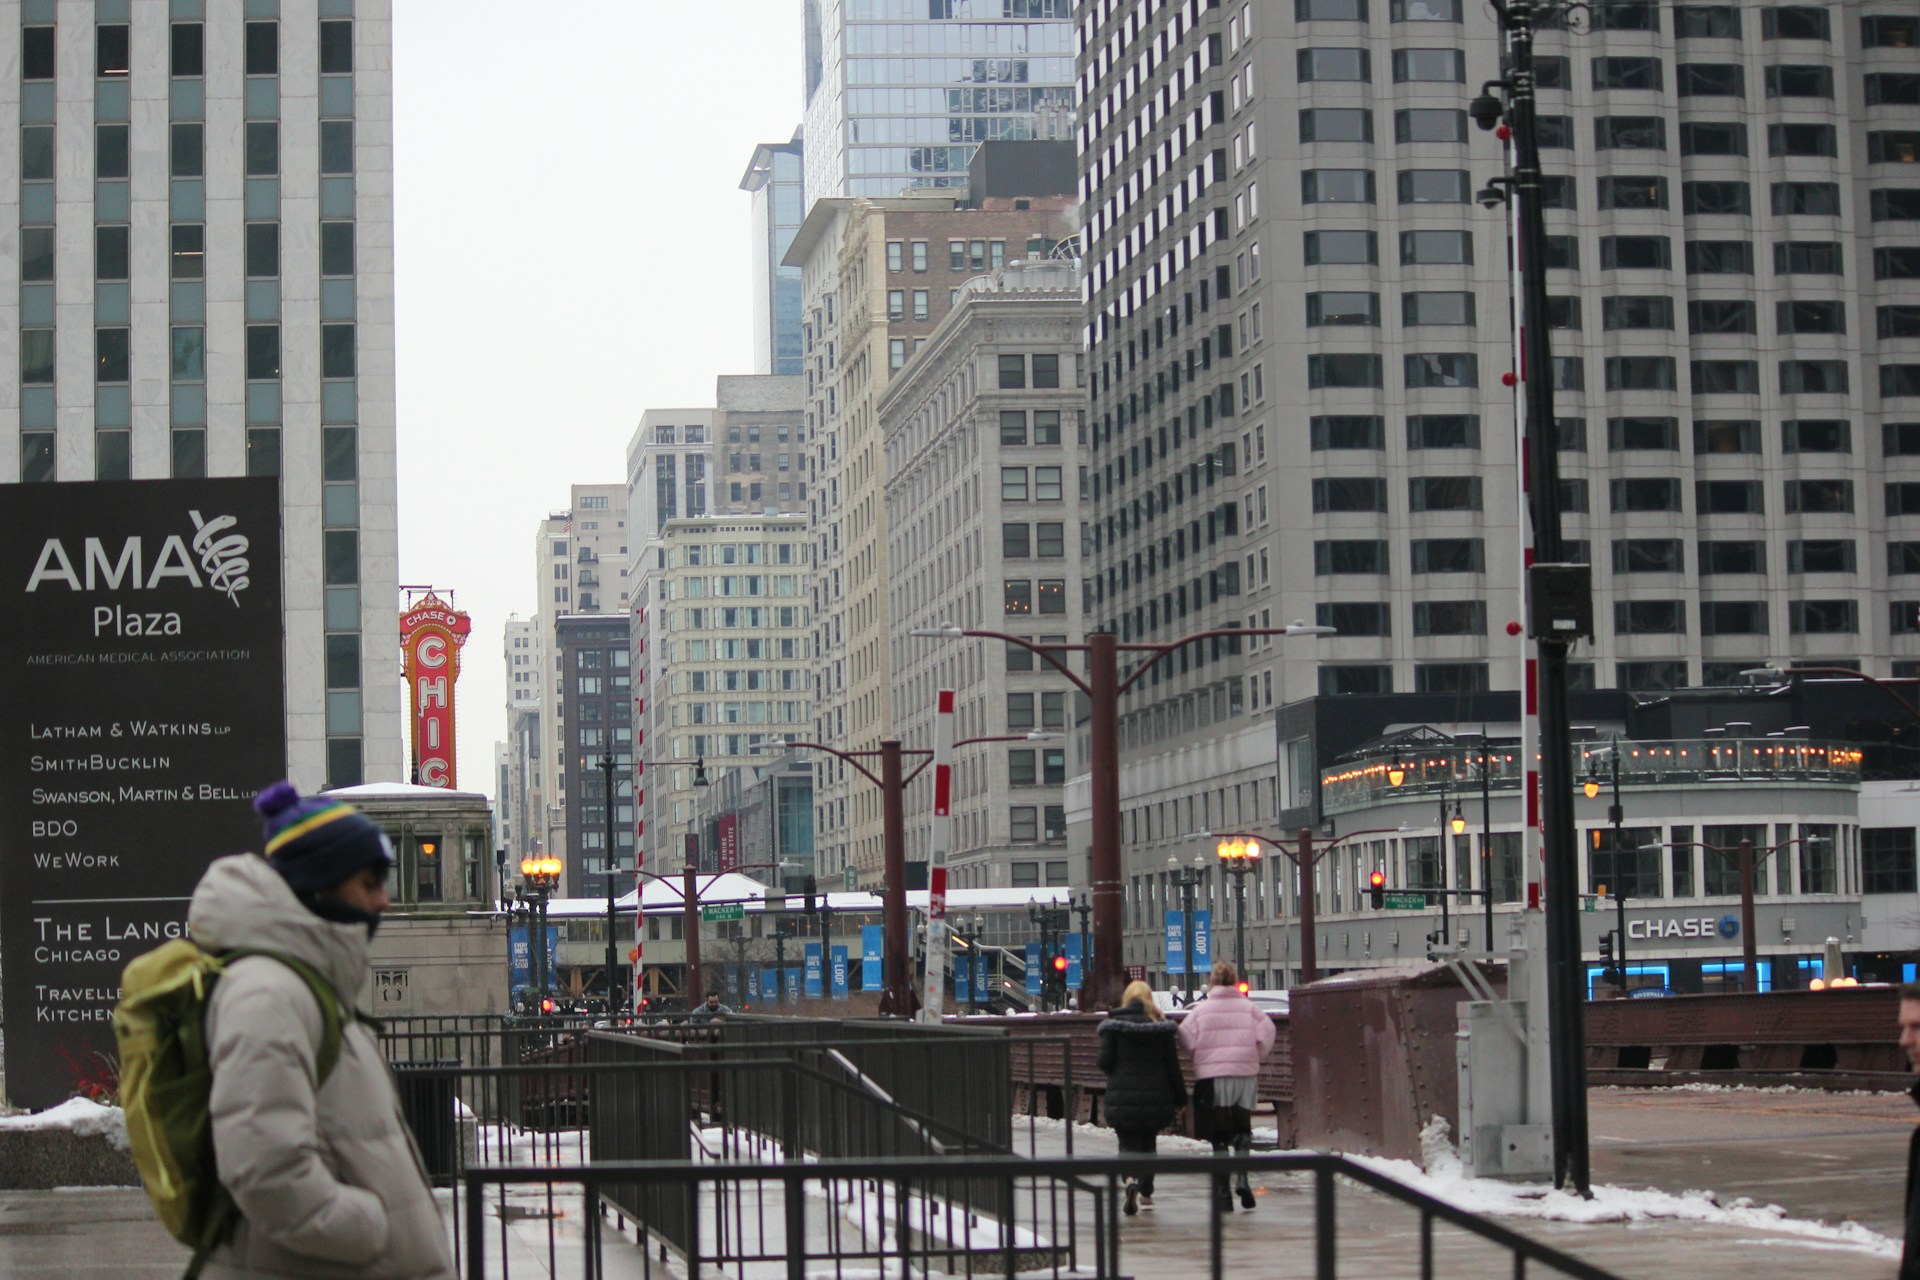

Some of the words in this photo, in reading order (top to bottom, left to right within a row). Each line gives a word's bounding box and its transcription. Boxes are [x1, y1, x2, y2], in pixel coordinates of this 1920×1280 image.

[25, 534, 204, 592] AMA
[93, 604, 182, 637] Plaza
[406, 611, 445, 626] CHASE
[26, 653, 95, 665] AMERICAN
[99, 652, 157, 664] MEDICAL
[160, 649, 250, 662] ASSOCIATION
[110, 722, 123, 737] &
[214, 725, 231, 735] LLP
[181, 785, 195, 800] &
[241, 790, 258, 799] LLP
[32, 820, 78, 837] BDO
[709, 906, 735, 914] WACKER
[34, 918, 92, 941] THE
[1628, 917, 1716, 939] CHASE
[1195, 931, 1207, 954] LOOP
[834, 964, 844, 985] LOOP
